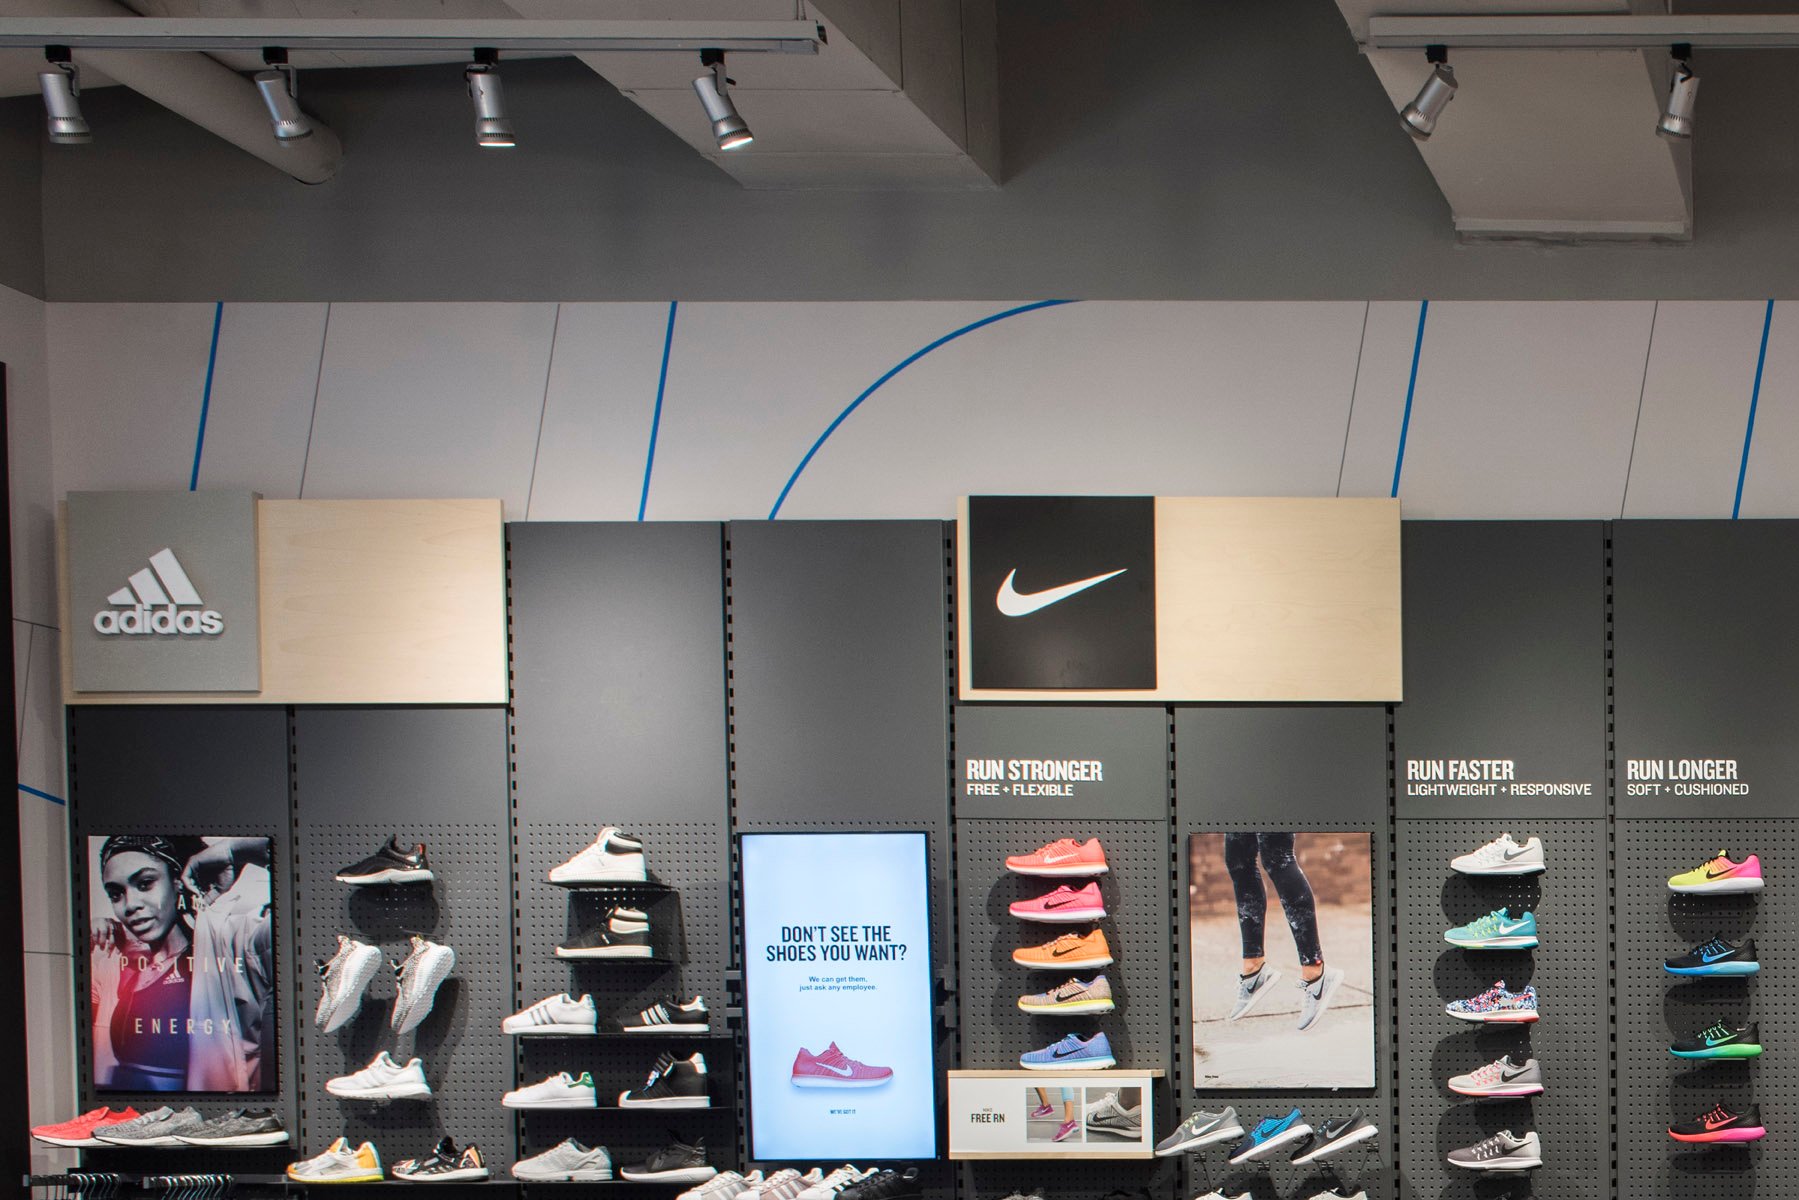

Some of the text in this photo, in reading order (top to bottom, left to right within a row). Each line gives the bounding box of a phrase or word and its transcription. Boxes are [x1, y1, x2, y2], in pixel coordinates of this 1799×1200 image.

[93, 603, 224, 634] adidas
[966, 759, 1103, 781] RUN STRONGER
[1407, 760, 1514, 781] RUN FASTER
[1627, 759, 1738, 780] RUN LONGER
[966, 783, 1000, 796] FREE
[1012, 784, 1074, 796] FLEXIBLE
[1407, 783, 1497, 796] LIGHTWEIGHT
[1510, 783, 1592, 796] RESPONSIVE
[1626, 783, 1662, 796] SOFT
[1674, 783, 1749, 796] CUSHIONED
[781, 925, 891, 943] DON'T SEE THE
[766, 944, 907, 962] SHOES YOU WANT?
[120, 956, 244, 973] POSITIVE
[799, 984, 813, 992] just
[835, 976, 847, 984] get
[134, 1018, 232, 1034] ENERGY
[971, 1113, 1005, 1123] FREE RN
